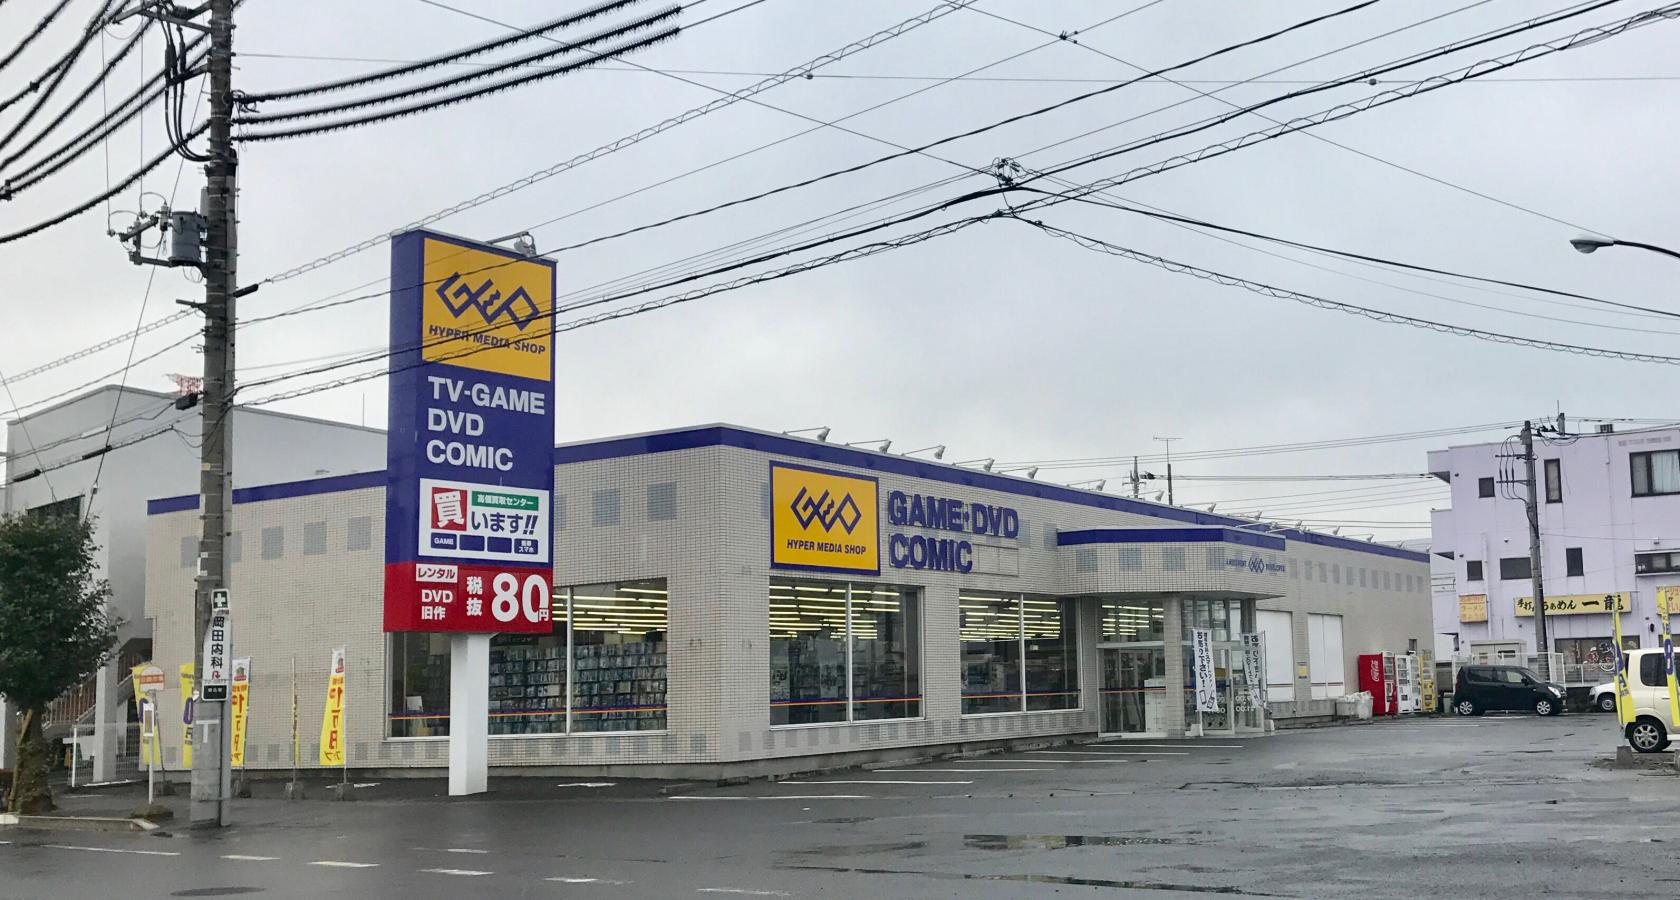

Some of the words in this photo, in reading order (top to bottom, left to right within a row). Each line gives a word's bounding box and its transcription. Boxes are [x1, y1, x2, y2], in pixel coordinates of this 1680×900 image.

[429, 324, 471, 342] HYPER
[473, 333, 510, 349] MEDIA
[514, 342, 546, 355] SHOP
[428, 376, 545, 415] TV-GAME
[428, 408, 484, 437] DVD
[427, 439, 514, 471] COMIC
[434, 537, 454, 545] GAME
[786, 539, 815, 551] HYPER
[817, 542, 842, 553] MEDIA
[844, 544, 867, 555] SHOP
[889, 533, 973, 574] COMIC
[418, 568, 455, 579] レンタル
[421, 589, 453, 604] DVD
[421, 606, 446, 620] 旧作
[211, 616, 225, 669] 岡田内科
